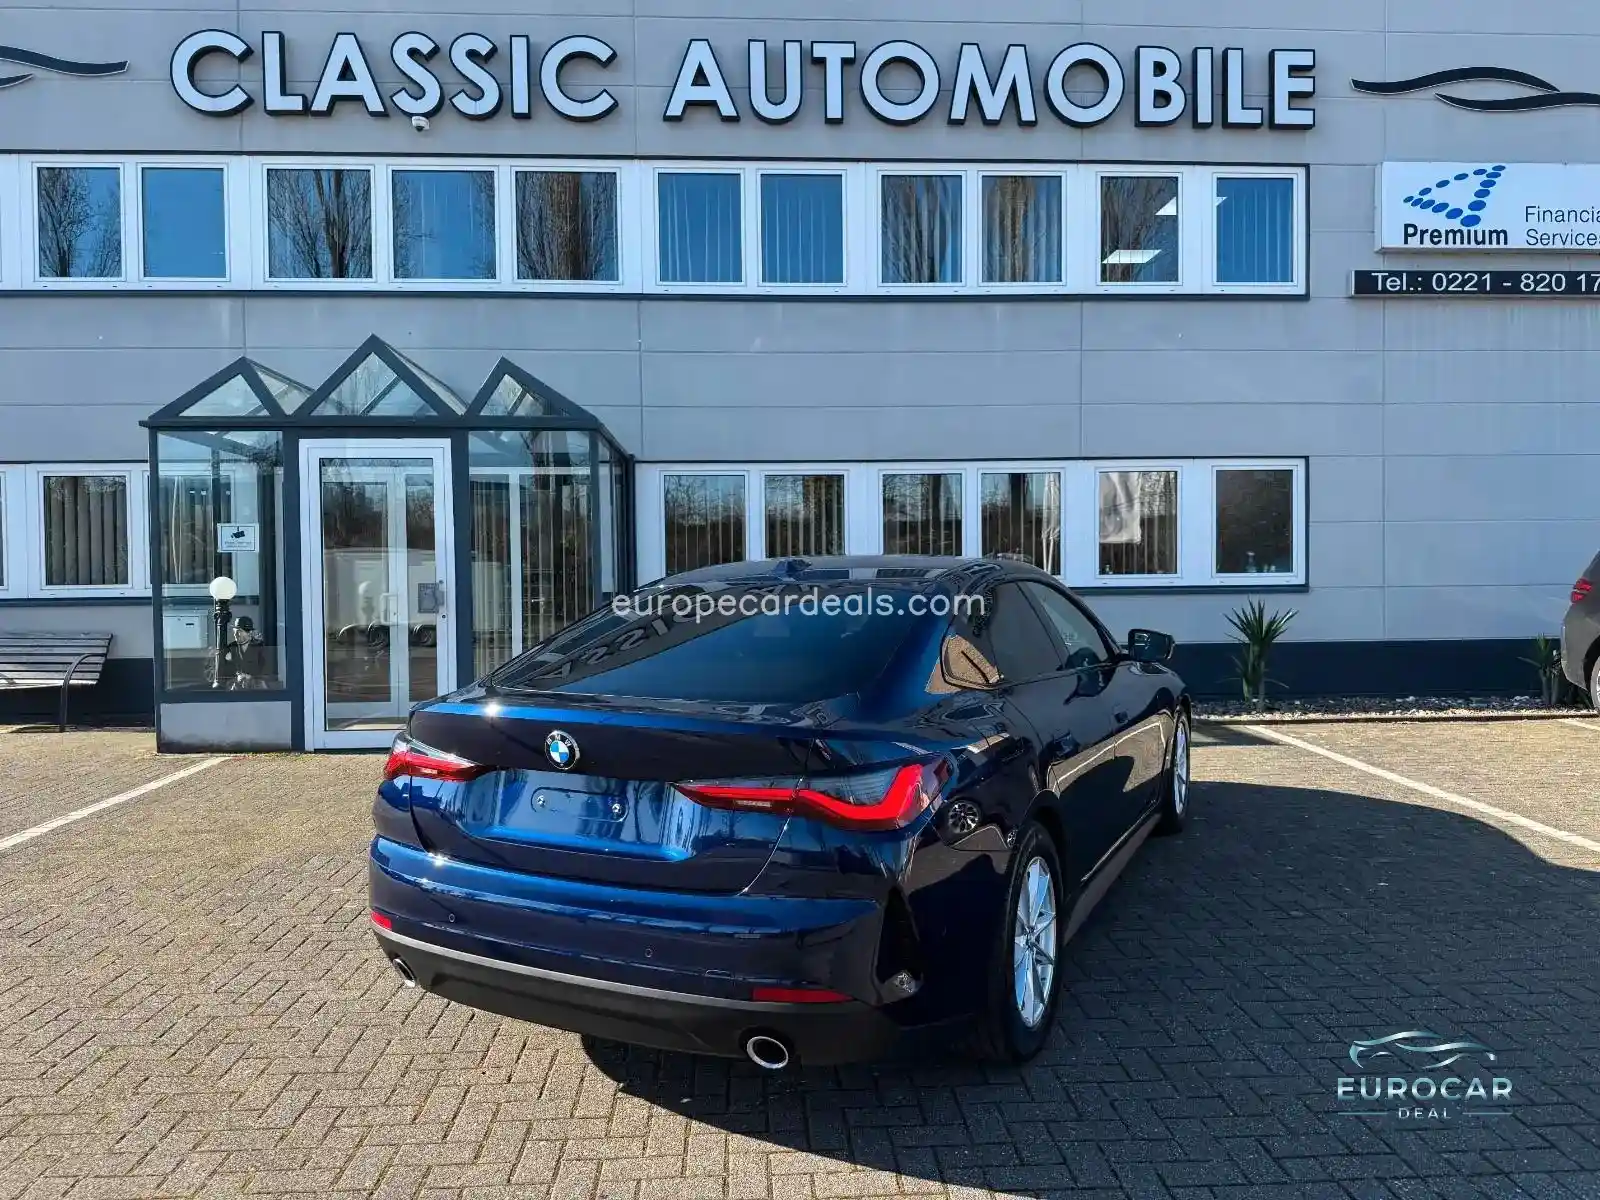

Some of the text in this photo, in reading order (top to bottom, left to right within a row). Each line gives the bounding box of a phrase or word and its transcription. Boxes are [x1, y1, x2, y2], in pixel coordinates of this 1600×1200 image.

[169, 29, 1317, 129] CLASSIC AUTOMOBILE
[1403, 223, 1508, 246] Premium
[1525, 228, 1600, 246] Service
[1371, 272, 1422, 291] Tel.:
[1432, 272, 1491, 291] 0221
[1520, 273, 1566, 292] 820
